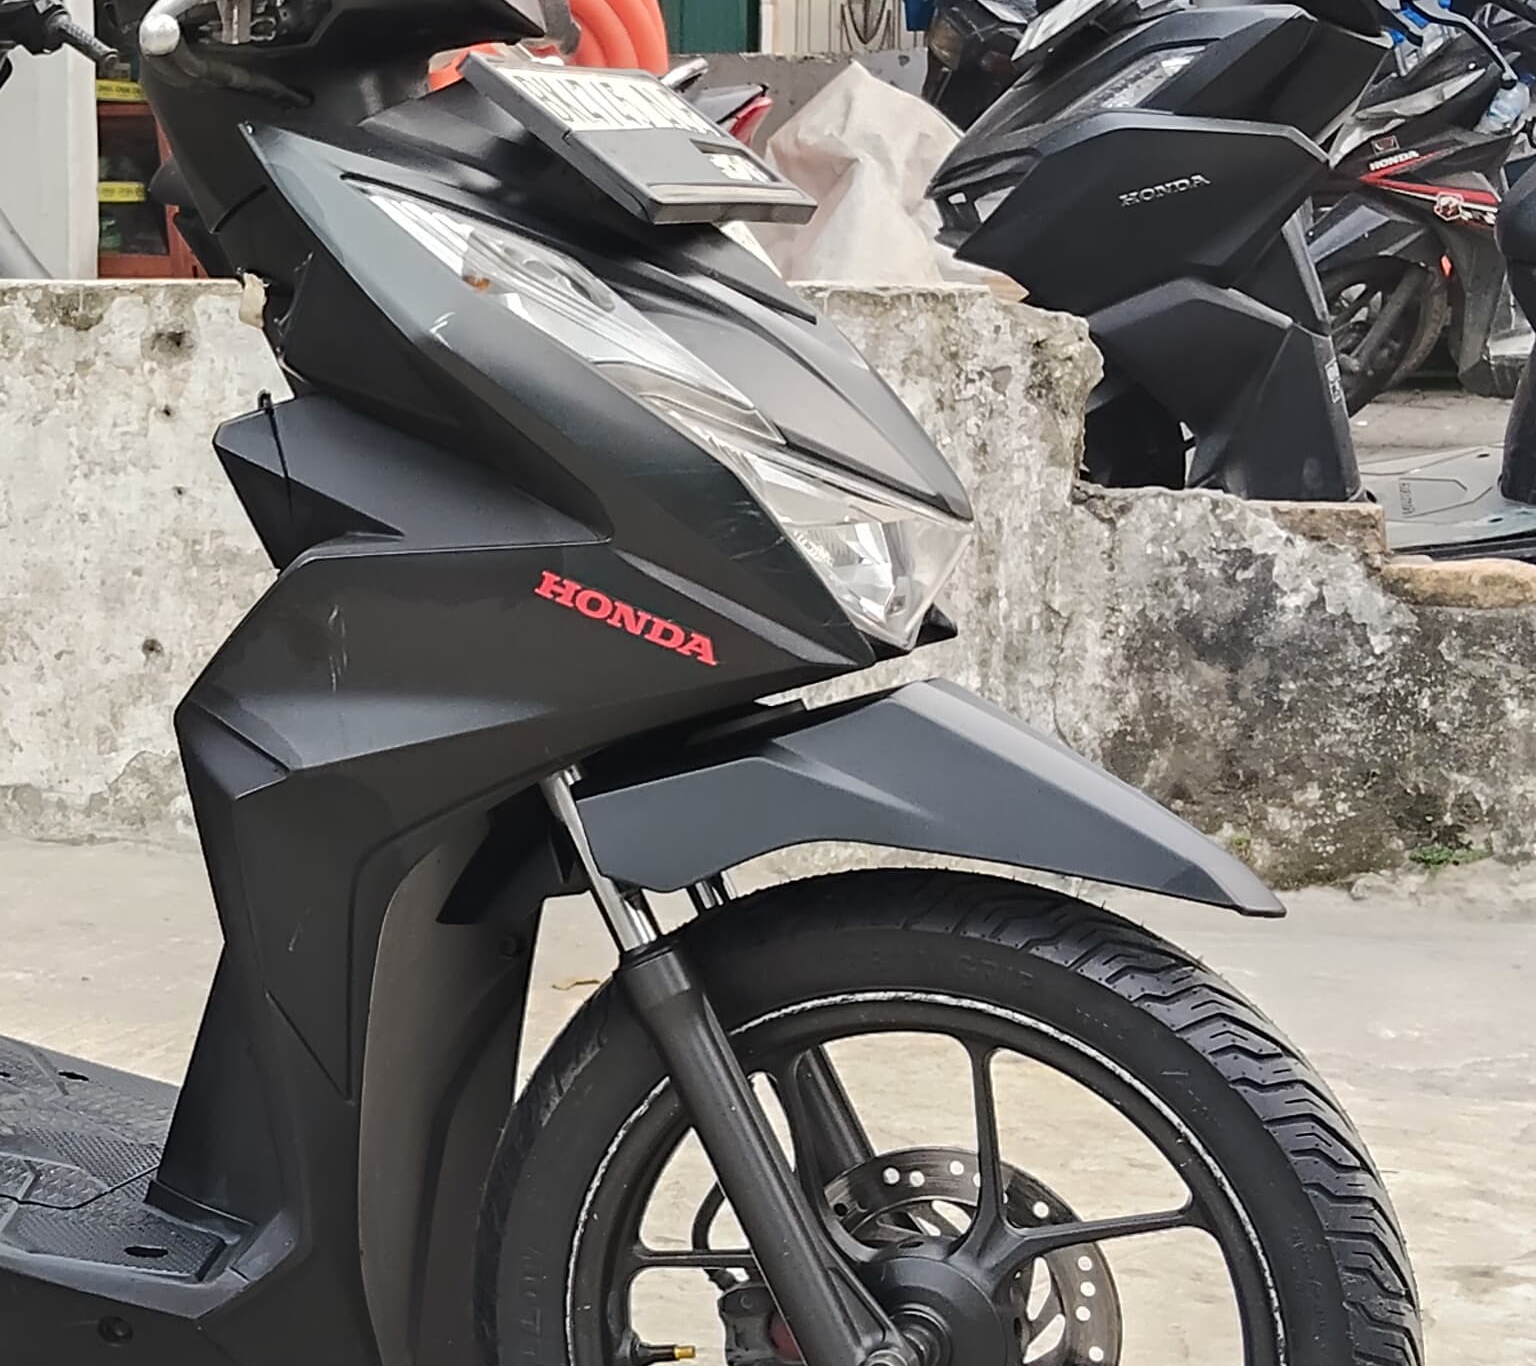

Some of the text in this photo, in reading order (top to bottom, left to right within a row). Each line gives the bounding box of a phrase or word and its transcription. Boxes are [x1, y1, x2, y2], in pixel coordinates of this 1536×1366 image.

[1368, 149, 1421, 173] HONDA
[1119, 173, 1212, 208] HONDA
[534, 570, 718, 666] HONDA
